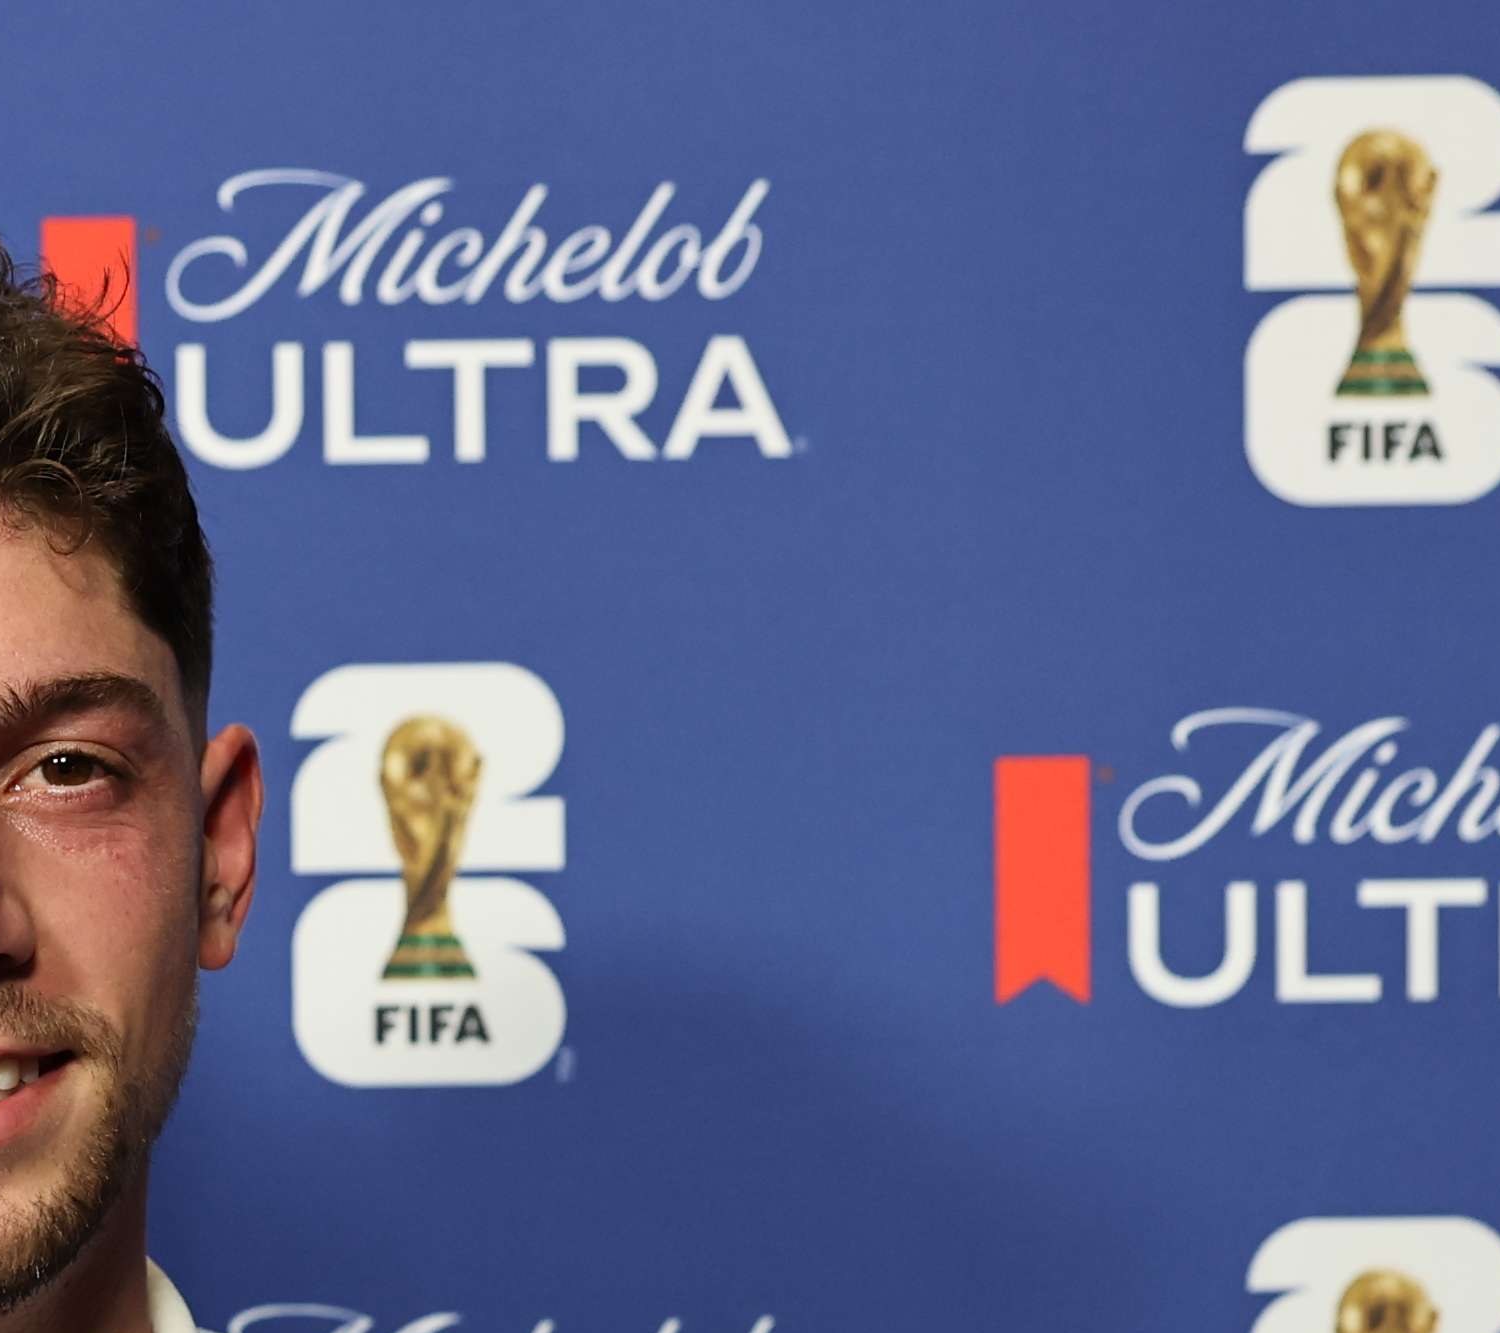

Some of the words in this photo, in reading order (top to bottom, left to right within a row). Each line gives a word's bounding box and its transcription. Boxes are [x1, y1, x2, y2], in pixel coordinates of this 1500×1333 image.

[164, 168, 770, 323] Michelob
[174, 334, 794, 471] ULTRA
[1327, 422, 1444, 463] FIFA
[374, 1003, 491, 1046] FIFA
